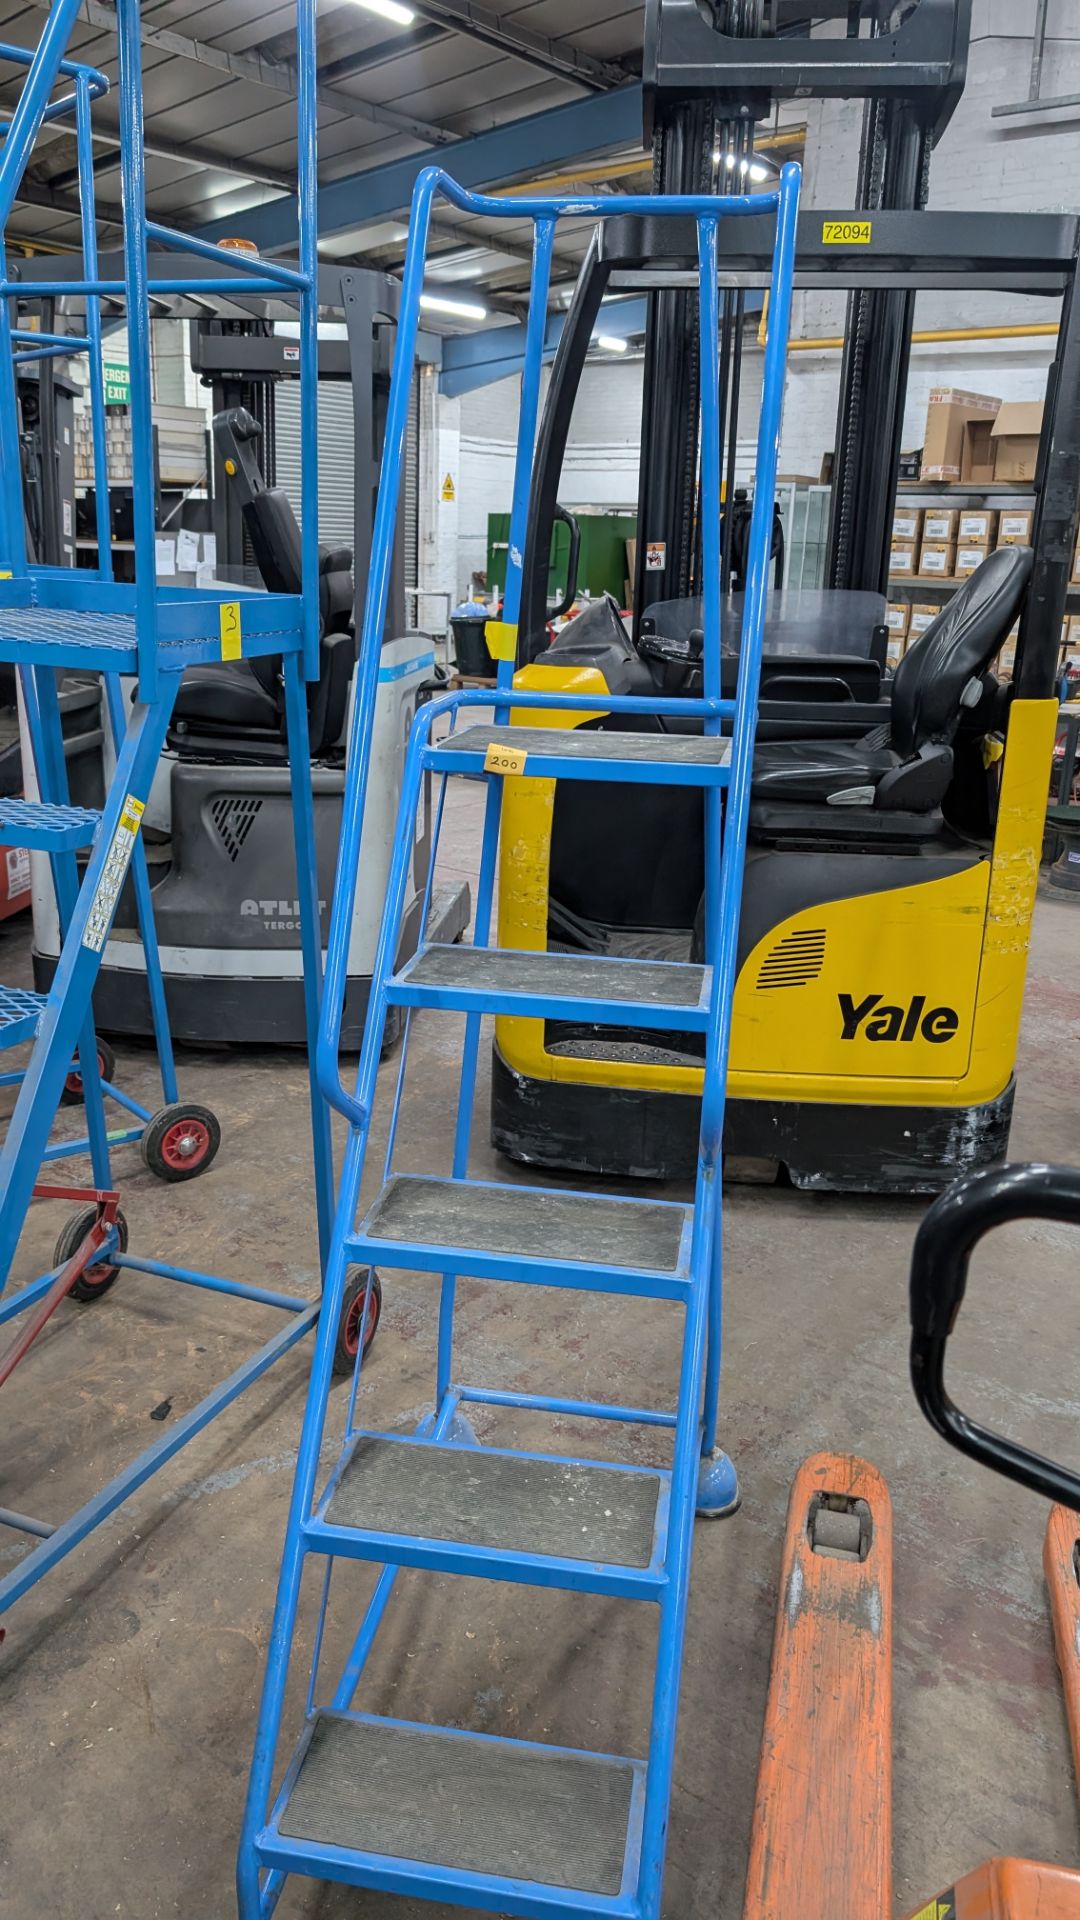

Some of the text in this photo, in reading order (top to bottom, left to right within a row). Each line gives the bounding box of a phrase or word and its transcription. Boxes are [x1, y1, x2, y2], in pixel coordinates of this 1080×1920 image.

[824, 224, 870, 240] 72094
[108, 385, 127, 401] EXIT
[225, 605, 237, 633] 3
[490, 755, 518, 770] 200
[837, 993, 959, 1044] Yale
